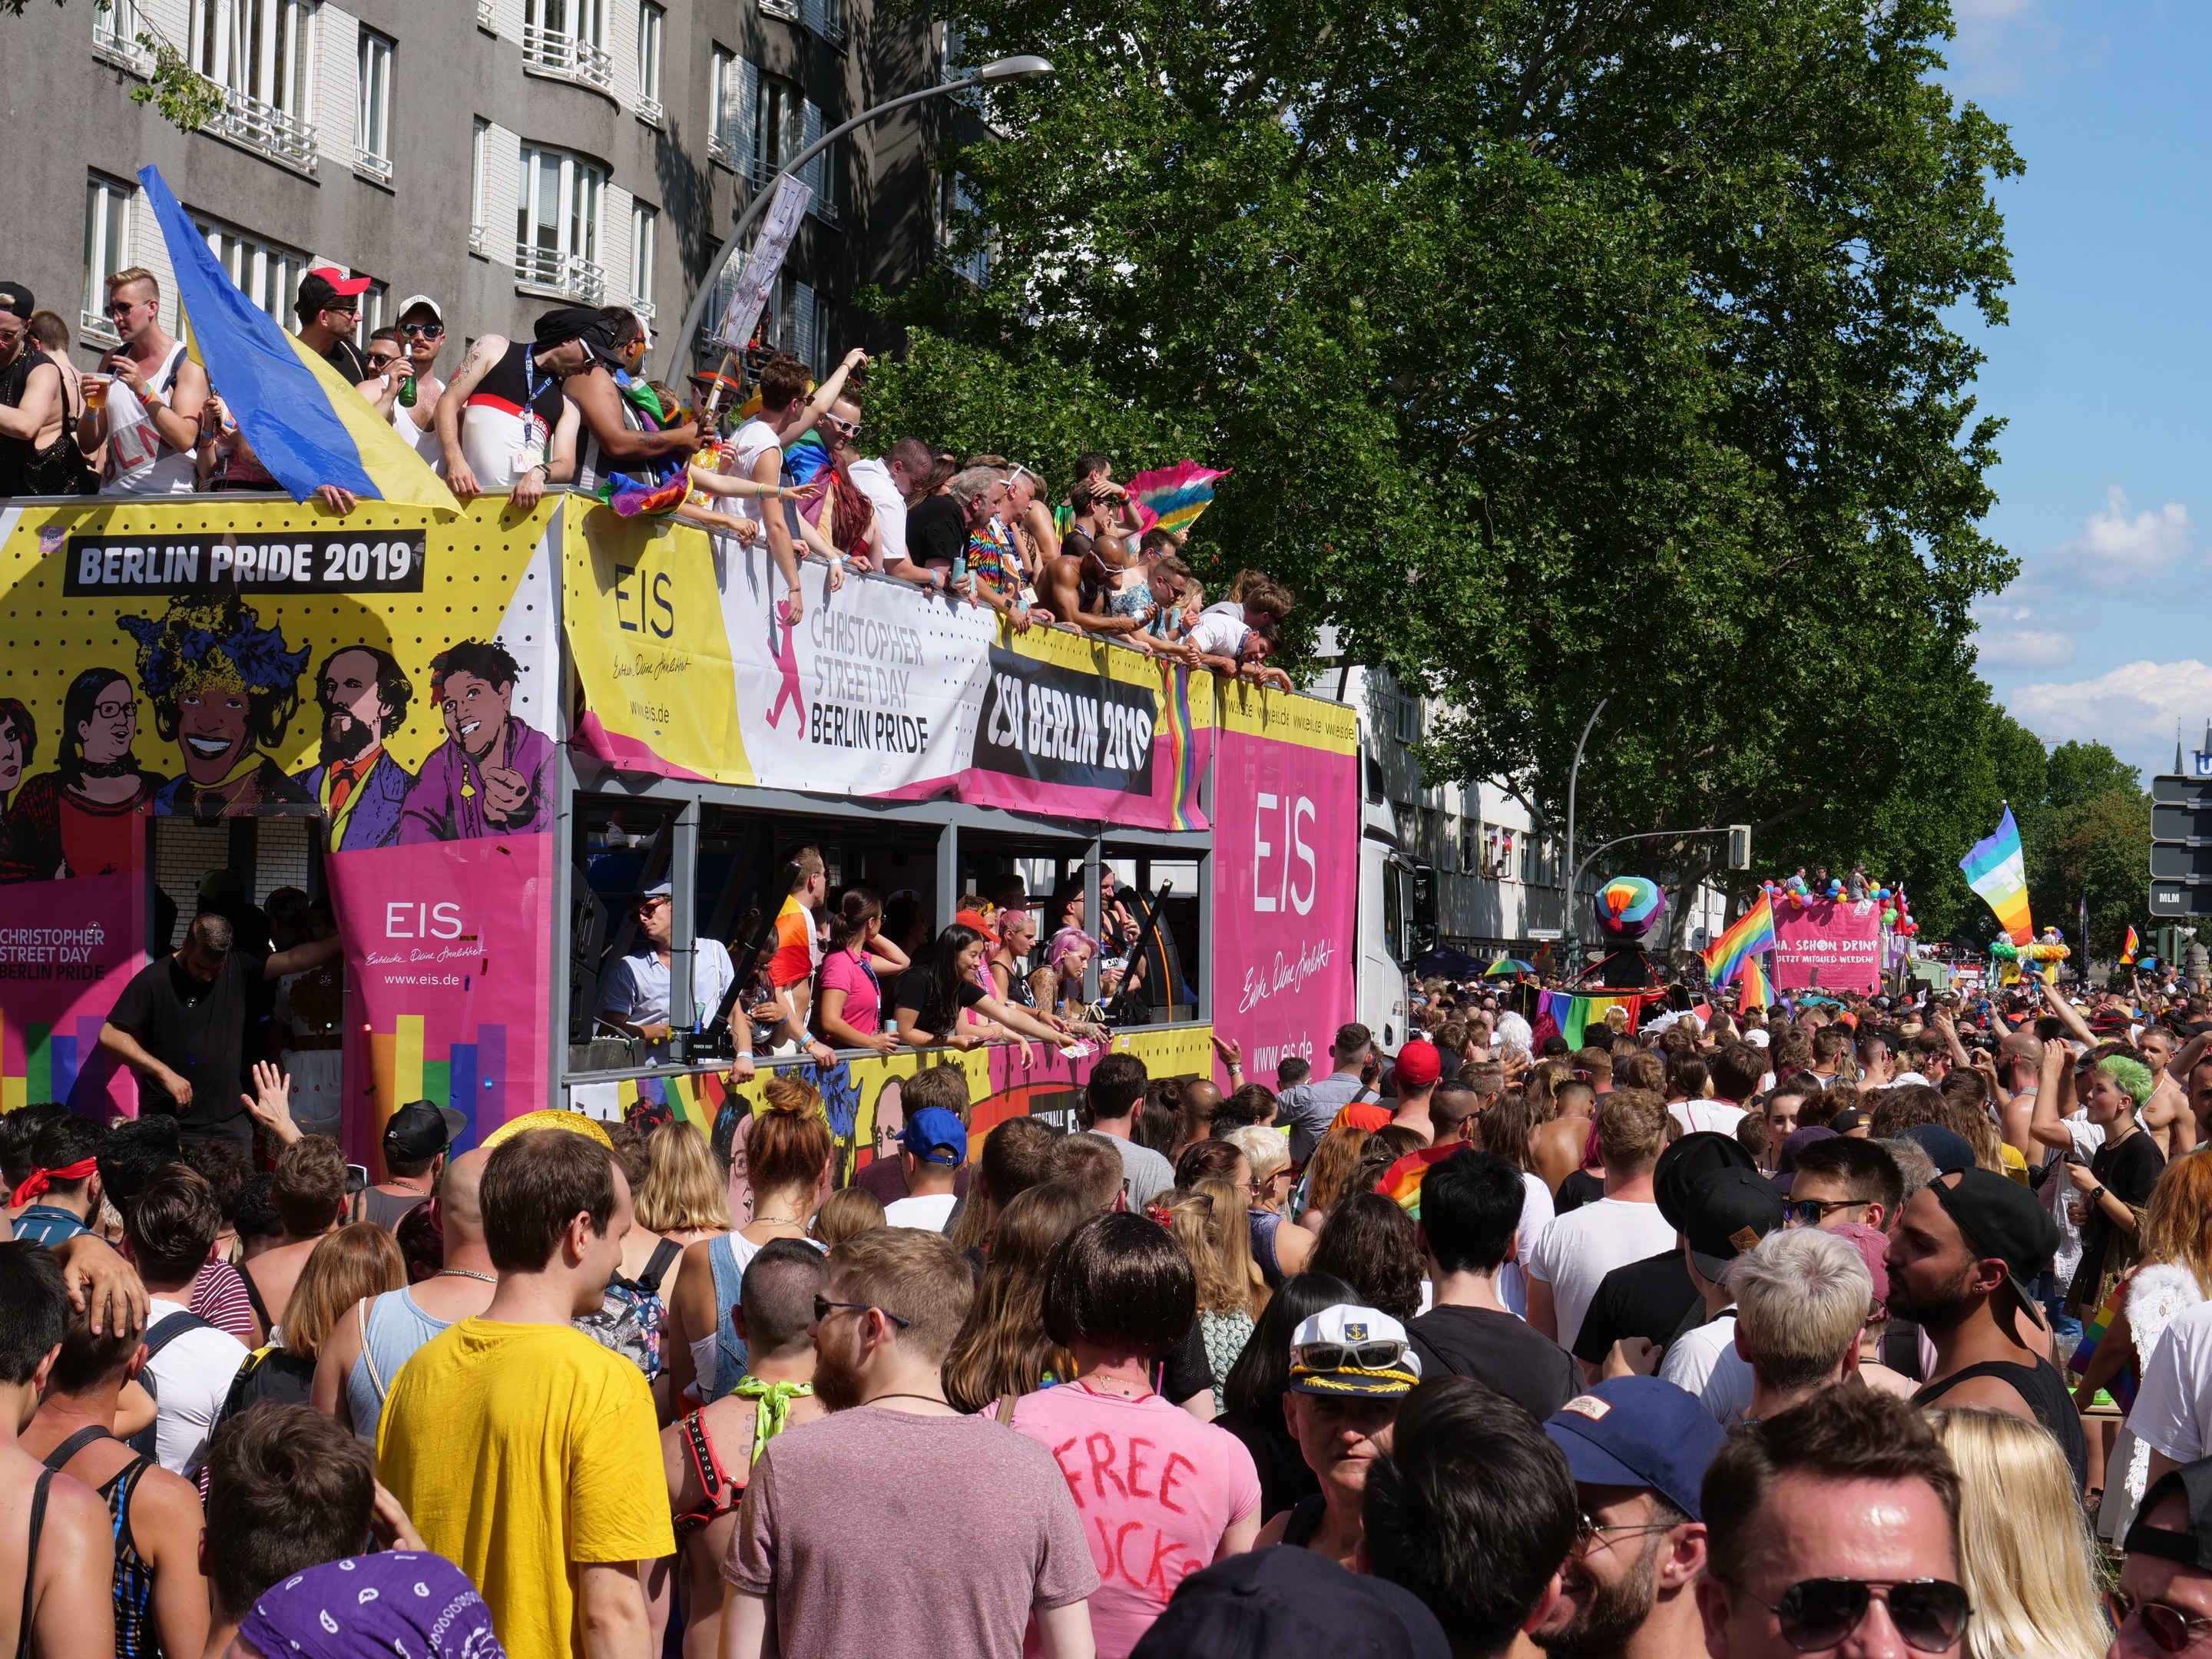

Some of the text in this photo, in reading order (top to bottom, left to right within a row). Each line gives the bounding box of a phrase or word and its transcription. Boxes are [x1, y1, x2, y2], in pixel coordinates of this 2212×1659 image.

[79, 541, 412, 584] BERLIN PRIDE 2019
[615, 563, 674, 639] EIS
[811, 607, 924, 666] CHRISTOPHER
[814, 654, 910, 708] STREET DAY
[812, 702, 928, 754] BERLIN PRIDE
[988, 672, 1152, 771] CSD BERLIN 2019
[1253, 792, 1316, 916] EIS
[2159, 893, 2180, 903] MLM
[0, 929, 104, 945] CHRISTOPHER
[386, 902, 462, 939] EIS
[0, 946, 91, 963] STREET DAY
[366, 952, 407, 966] Entdecke
[410, 948, 435, 962] Deine
[1777, 955, 1874, 964] JETZT MITGLIED WERDEN!
[1842, 939, 1877, 952] DRIN?
[0, 963, 104, 980] BERLIN PRIDE
[384, 973, 459, 985] www.eis.de
[1052, 1431, 1197, 1515] FREE
